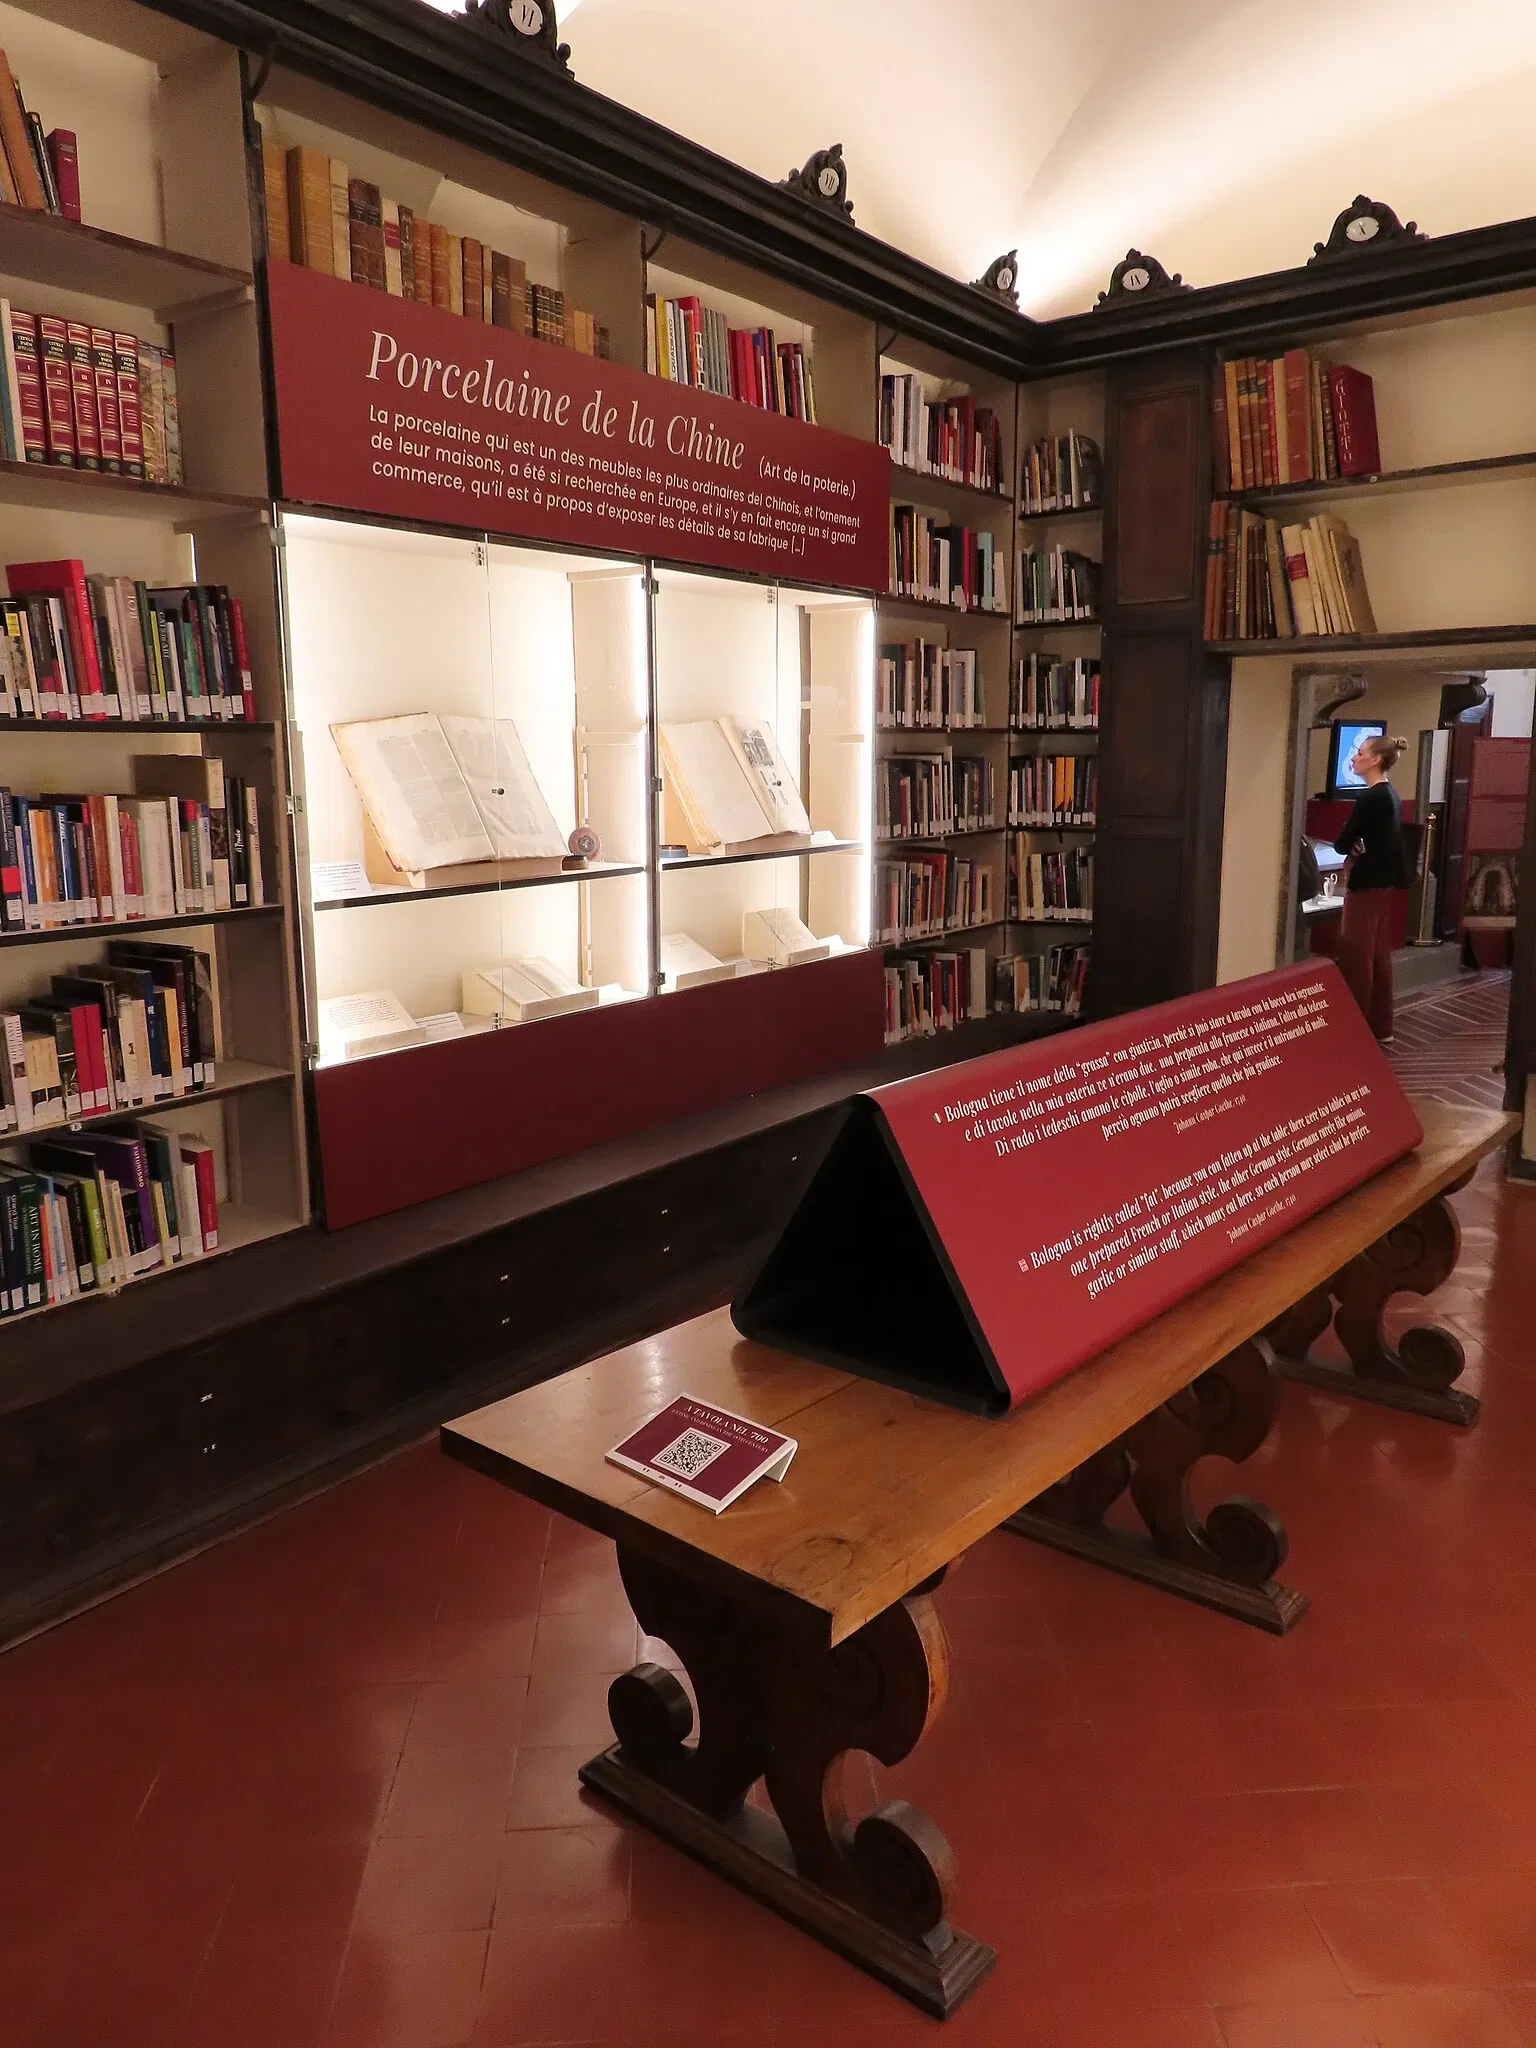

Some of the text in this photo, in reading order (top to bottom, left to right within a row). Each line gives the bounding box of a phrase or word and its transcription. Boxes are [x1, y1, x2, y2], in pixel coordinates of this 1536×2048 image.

[521, 4, 534, 27] VI
[367, 331, 743, 469] Porcelaine de la Chine
[1335, 379, 1352, 463] GIOTTO
[369, 404, 387, 424] La
[394, 413, 480, 443] porcelaine
[485, 434, 508, 452] qui
[513, 440, 534, 455] est
[539, 445, 556, 460] un
[561, 448, 584, 466] des
[588, 457, 641, 478] meubles
[645, 466, 661, 483] les
[665, 473, 688, 489] plus
[692, 480, 744, 501] ordinaires
[765, 495, 801, 516] Chinois,
[804, 505, 812, 517] et
[370, 431, 392, 450] de
[399, 436, 430, 457] leur
[435, 447, 503, 475] maisons,
[509, 463, 518, 475] a
[523, 462, 545, 481] été
[549, 469, 560, 484] si
[565, 474, 636, 499] recherchée
[640, 490, 654, 503] en
[658, 491, 698, 514] Europe,
[701, 502, 712, 515] et
[715, 502, 721, 517] il
[740, 511, 753, 523] en
[756, 511, 771, 527] fait
[774, 519, 805, 534] encore
[808, 526, 819, 537] un
[821, 526, 829, 539] si
[830, 531, 856, 544] grand
[759, 455, 855, 500] (Art de la poterie.)
[372, 461, 465, 492] commerce,
[507, 486, 528, 501] est
[533, 487, 541, 504] à
[546, 494, 592, 514] propos
[658, 512, 674, 528] les
[678, 517, 714, 535] détails
[717, 524, 730, 538] de
[733, 530, 745, 541] sa
[748, 529, 788, 551] fabrique
[943, 1097, 988, 1121] Bologna
[989, 1087, 1015, 1106] tiene
[1015, 1079, 1025, 1096] il
[1025, 1075, 1052, 1093] nome
[1053, 1064, 1076, 1083] della
[1113, 1049, 1128, 1062] con
[1162, 1024, 1187, 1048] perché
[1187, 1023, 1195, 1036] si
[1194, 1017, 1208, 1037] può
[965, 1129, 971, 1141] e
[973, 1119, 985, 1138] di
[985, 1109, 1018, 1133] tavole
[1019, 1099, 1044, 1120] nella
[1045, 1092, 1064, 1111] mia
[1065, 1081, 1096, 1103] osteria
[1096, 1079, 1107, 1091] ve
[1158, 1055, 1174, 1068] una
[1173, 1041, 1209, 1065] preparata
[994, 1136, 1009, 1156] Di
[1010, 1128, 1034, 1150] rado
[1034, 1124, 1041, 1140] i
[1041, 1109, 1080, 1137] tedeschi
[1081, 1101, 1110, 1122] amano
[1109, 1095, 1119, 1109] le
[1173, 1074, 1179, 1084] o
[1179, 1063, 1201, 1082] simile
[1101, 1113, 1129, 1141] perciò
[1129, 1105, 1159, 1126] ognuno
[1158, 1092, 1181, 1116] potrà
[1180, 1084, 1210, 1104] scegliere
[133, 1146, 144, 1188] FUTURISMO
[29, 1206, 42, 1274] ART IN ROME
[1030, 1238, 1072, 1268] Bologna
[1071, 1230, 1082, 1246] is
[1083, 1213, 1114, 1240] rightly
[1115, 1197, 1141, 1224] called
[1160, 1175, 1192, 1199] because
[1192, 1167, 1208, 1182] you
[1070, 1257, 1088, 1276] one
[1088, 1229, 1131, 1269] prepared
[1130, 1214, 1161, 1242] French
[1161, 1211, 1170, 1225] or
[1170, 1197, 1199, 1219] Italian
[1087, 1268, 1115, 1299] garlic
[1115, 1263, 1126, 1279] or
[1127, 1245, 1158, 1272] similar
[1181, 1215, 1204, 1240] which
[730, 1422, 748, 1436] NEL
